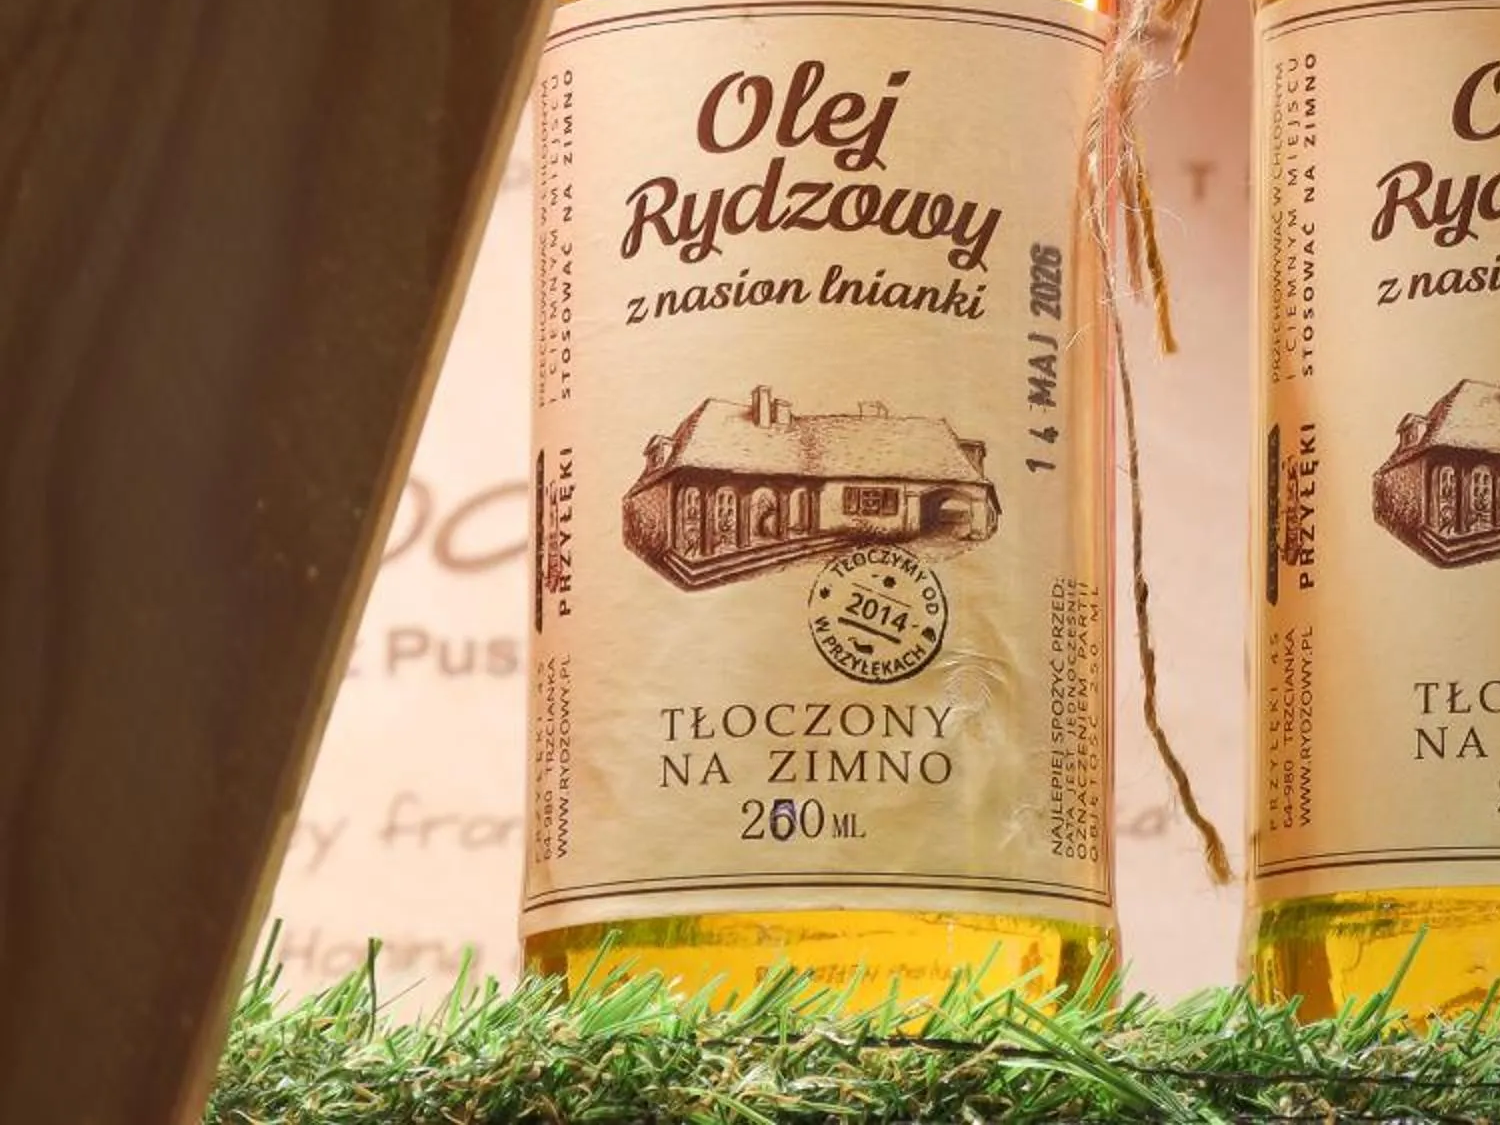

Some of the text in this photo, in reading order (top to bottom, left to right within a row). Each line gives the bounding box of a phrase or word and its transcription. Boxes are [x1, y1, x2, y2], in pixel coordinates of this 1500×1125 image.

[696, 60, 911, 172] Olej
[1287, 57, 1300, 187] MIEJSCU
[558, 70, 573, 400] STOSOWAĆ NA ZIMNO
[620, 156, 1003, 273] Rydzowy
[1301, 53, 1317, 378] STOSOWAĆ NA ZIMNO
[626, 264, 987, 324] z nasion lnianki
[1029, 242, 1061, 321] 2026
[1287, 209, 1297, 352] CIEMNYM
[1376, 276, 1402, 307] z
[1026, 331, 1058, 411] MAJ
[559, 446, 575, 616] PRZYŁĘKI
[1299, 423, 1318, 590] PRZYŁĘKI
[831, 548, 939, 615] TŁOCZYMY OD
[845, 592, 909, 632] 2014
[1051, 577, 1065, 653] PRZED:
[814, 616, 831, 633] W
[660, 704, 953, 741] TŁOCZONY
[1077, 581, 1089, 860] OZNACZENIEM PARTII
[1283, 630, 1296, 745] TRZCIANKA
[1299, 626, 1314, 828] WWW.RYDZOWY.PL
[557, 655, 571, 859] WWW.RYDZOWY.PL
[660, 749, 953, 788] NA ZIMNO
[1065, 749, 1076, 795] JEST
[1414, 725, 1488, 760] NA
[832, 813, 867, 838] ML
[1051, 750, 1065, 856] NAJLEPIEJ
[1065, 806, 1075, 858] DATA
